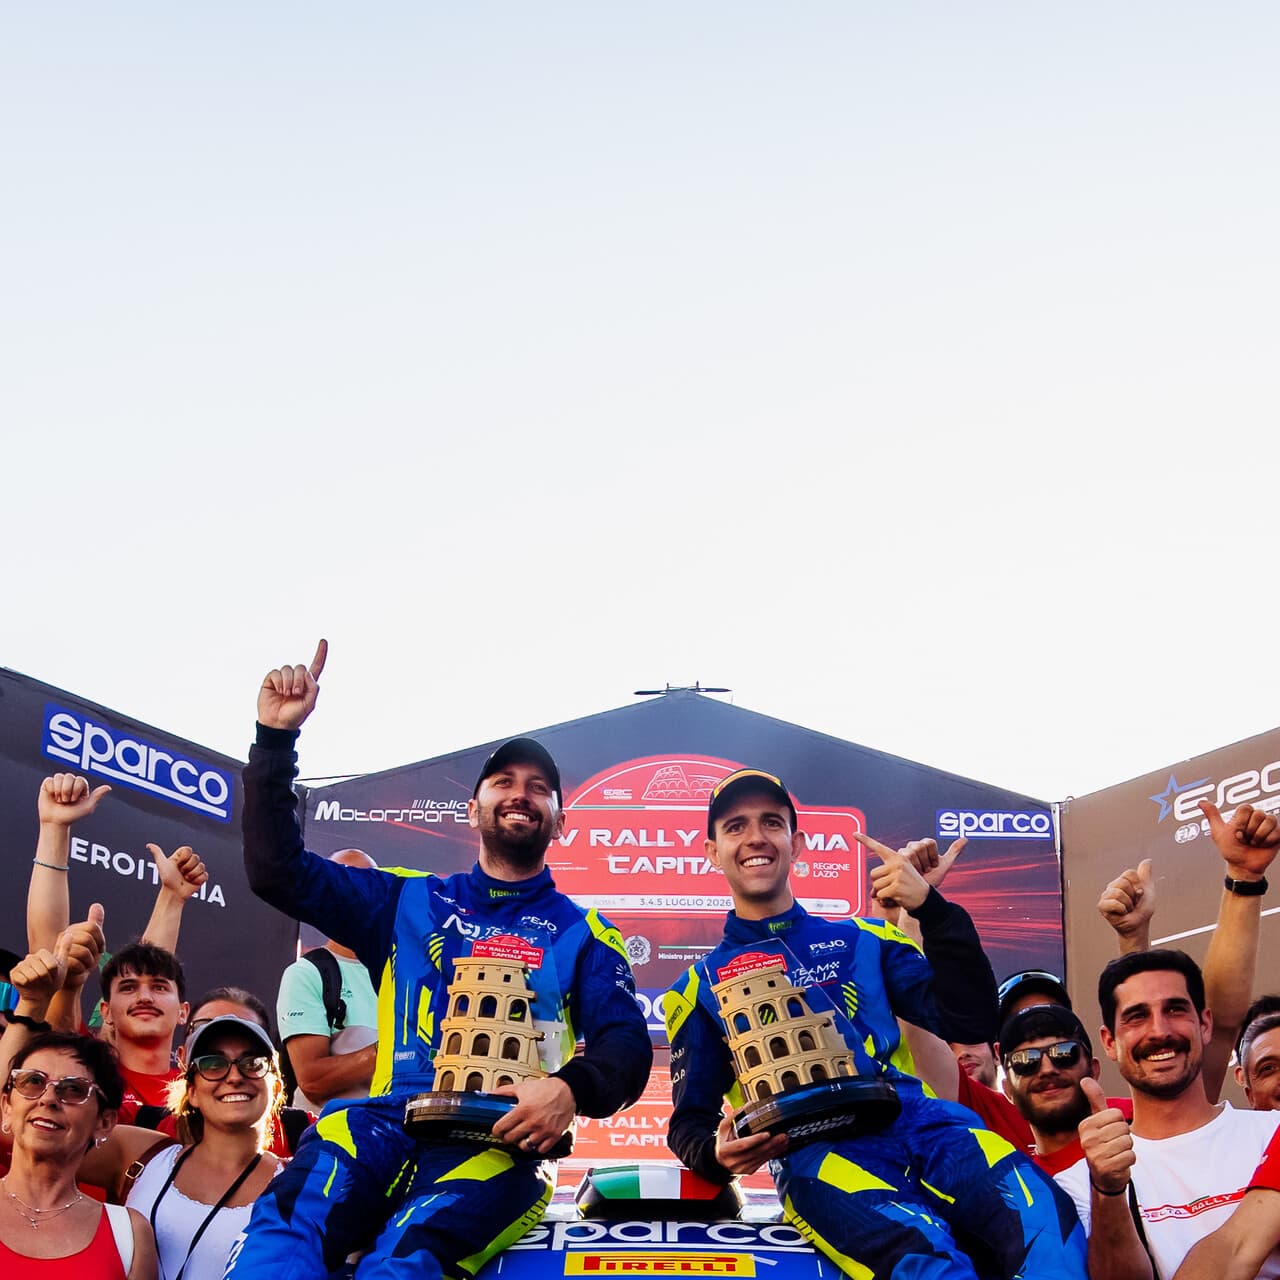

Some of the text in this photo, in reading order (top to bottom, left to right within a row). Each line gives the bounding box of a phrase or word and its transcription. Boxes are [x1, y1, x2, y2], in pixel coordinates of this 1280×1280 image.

[46, 712, 230, 818] sparco
[939, 812, 1051, 838] sparco
[590, 829, 700, 847] RALLY
[813, 862, 851, 871] REGIONE
[813, 869, 840, 878] LAZIO
[665, 898, 703, 907] LUGLIO
[706, 898, 732, 908] 2026
[521, 915, 558, 932] PEJO
[809, 939, 847, 951] PEJO
[658, 953, 683, 961] Ministro
[684, 954, 694, 963] per
[599, 1116, 669, 1129] RALLY
[1191, 1194, 1233, 1213] RALLY
[510, 1221, 816, 1252] sparco
[583, 1255, 738, 1272] PIRELLI
